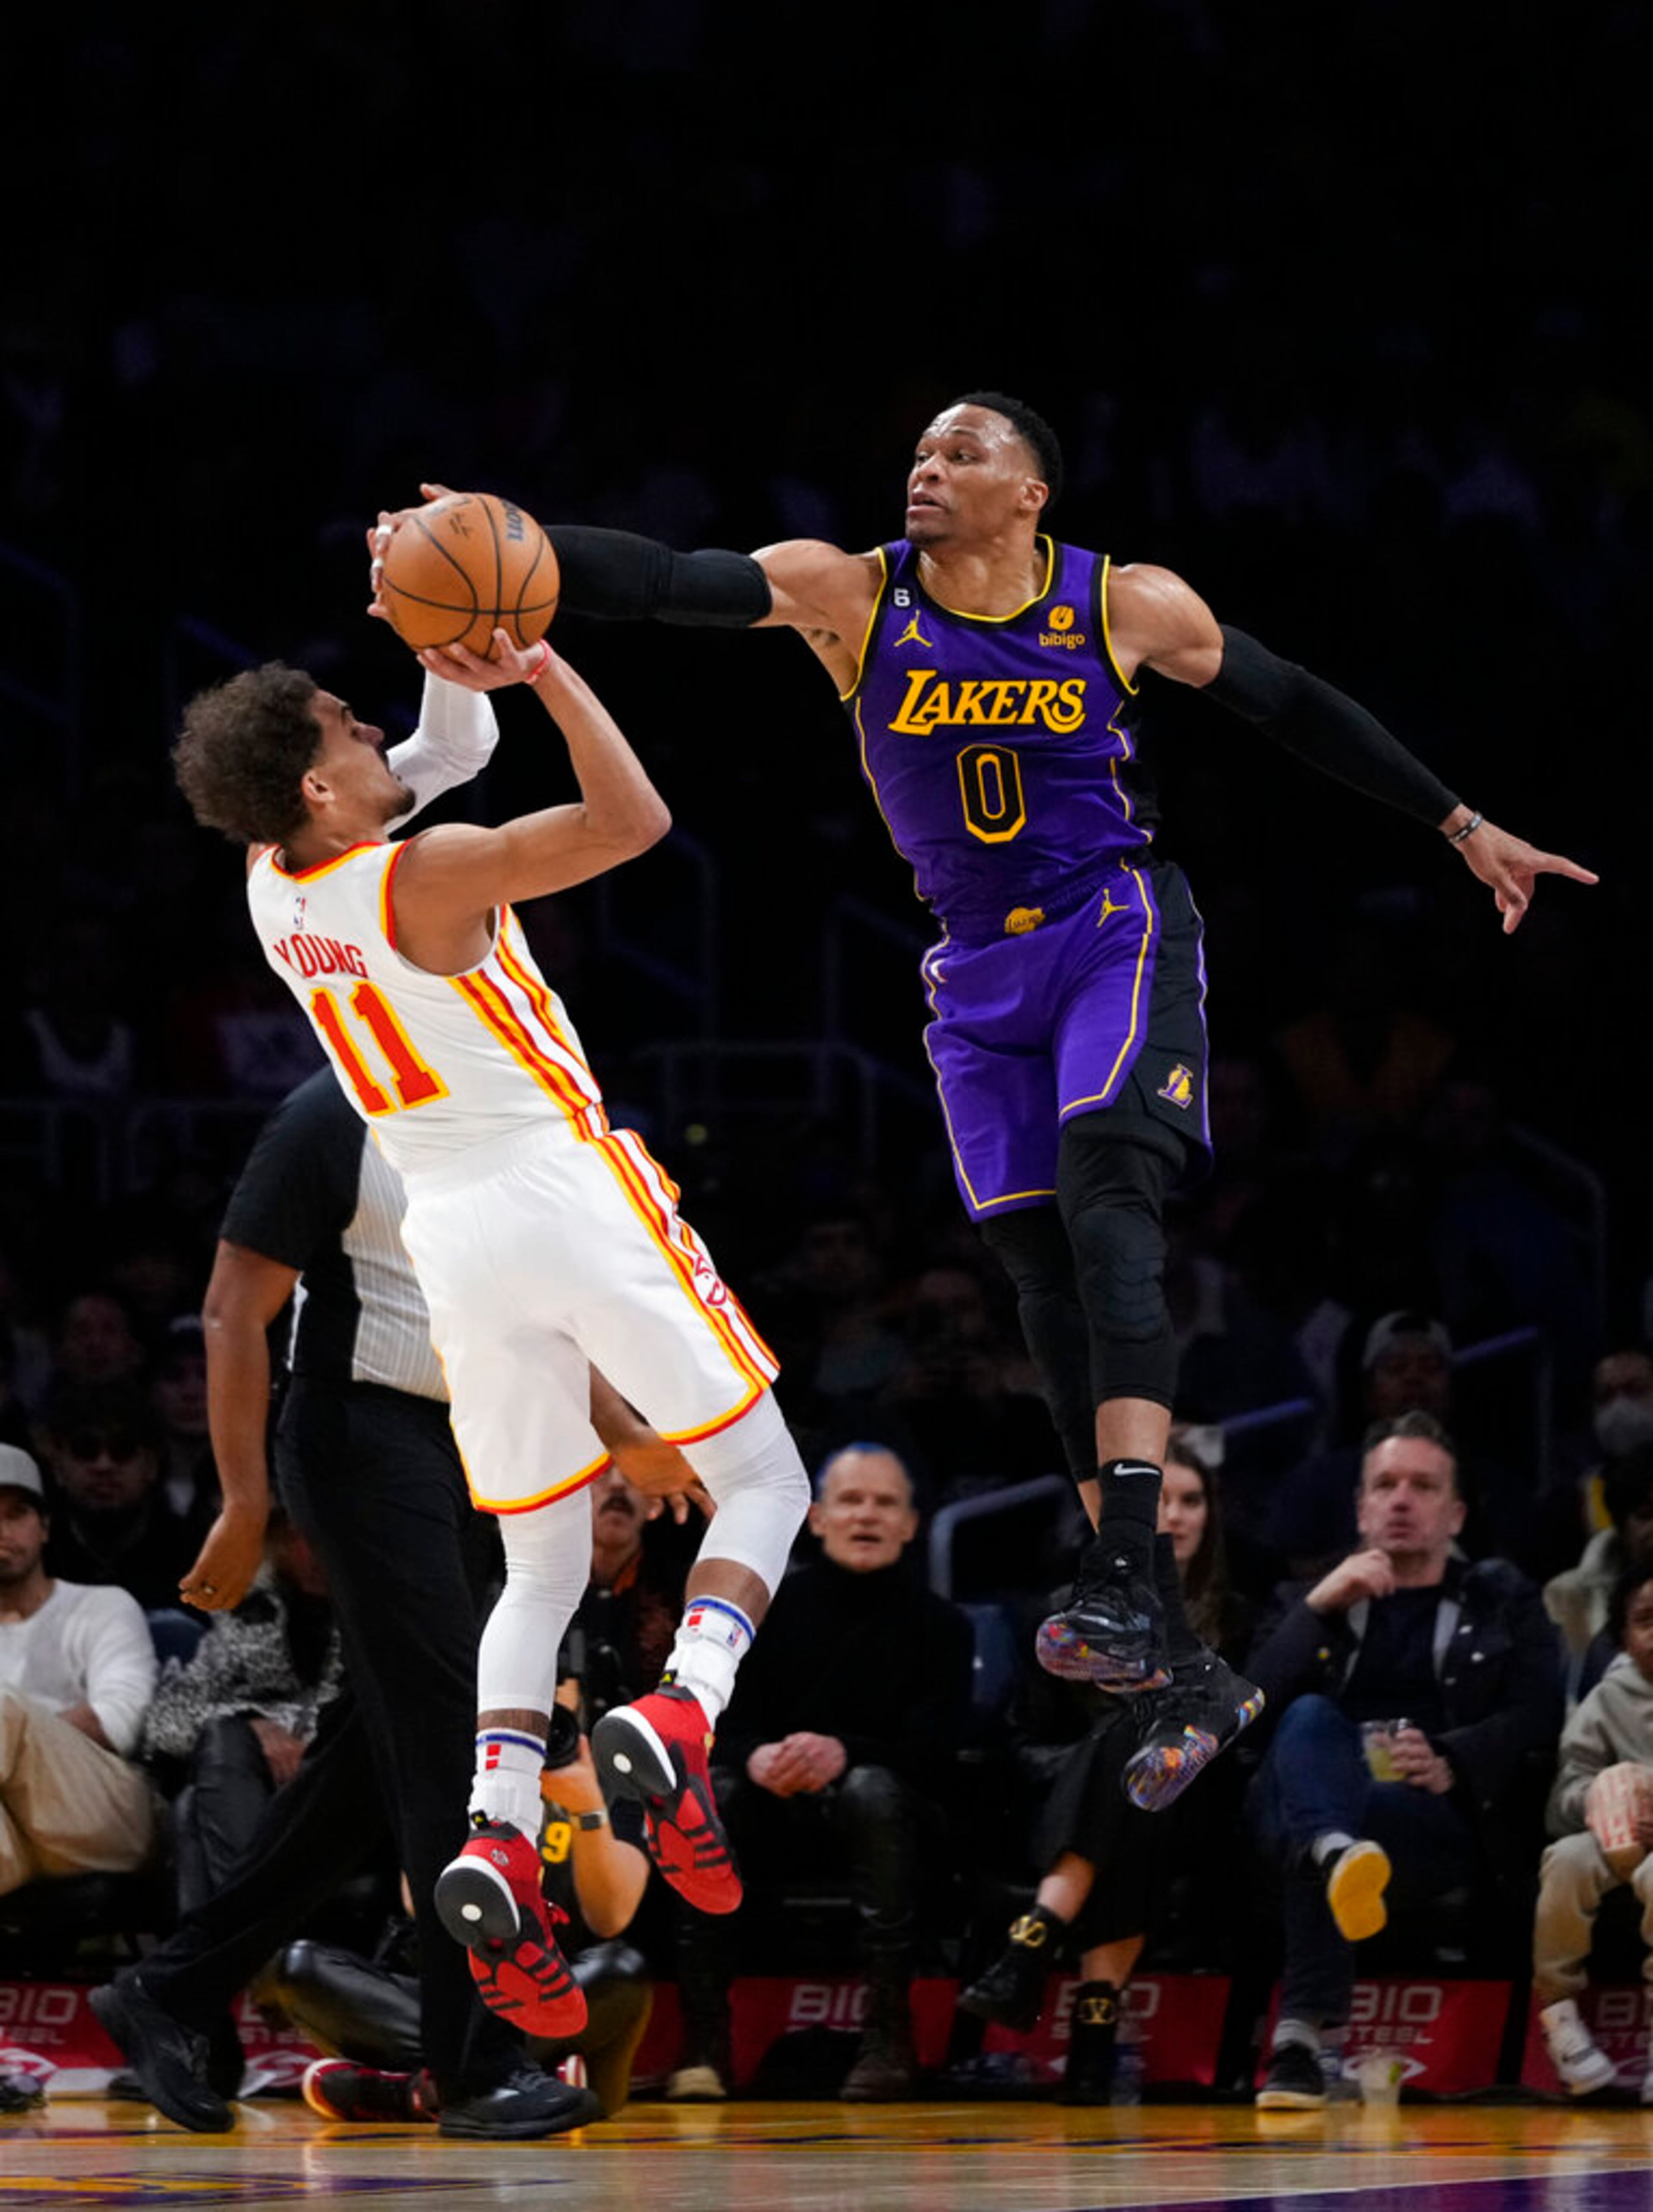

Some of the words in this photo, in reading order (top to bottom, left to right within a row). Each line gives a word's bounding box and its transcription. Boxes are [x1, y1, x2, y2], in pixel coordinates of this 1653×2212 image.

[894, 587, 910, 607] 6
[1039, 632, 1085, 650] bibigo
[957, 744, 1026, 844] 0
[273, 933, 369, 979] YOUNG
[311, 979, 450, 1117] 11
[542, 1821, 571, 1863] 9
